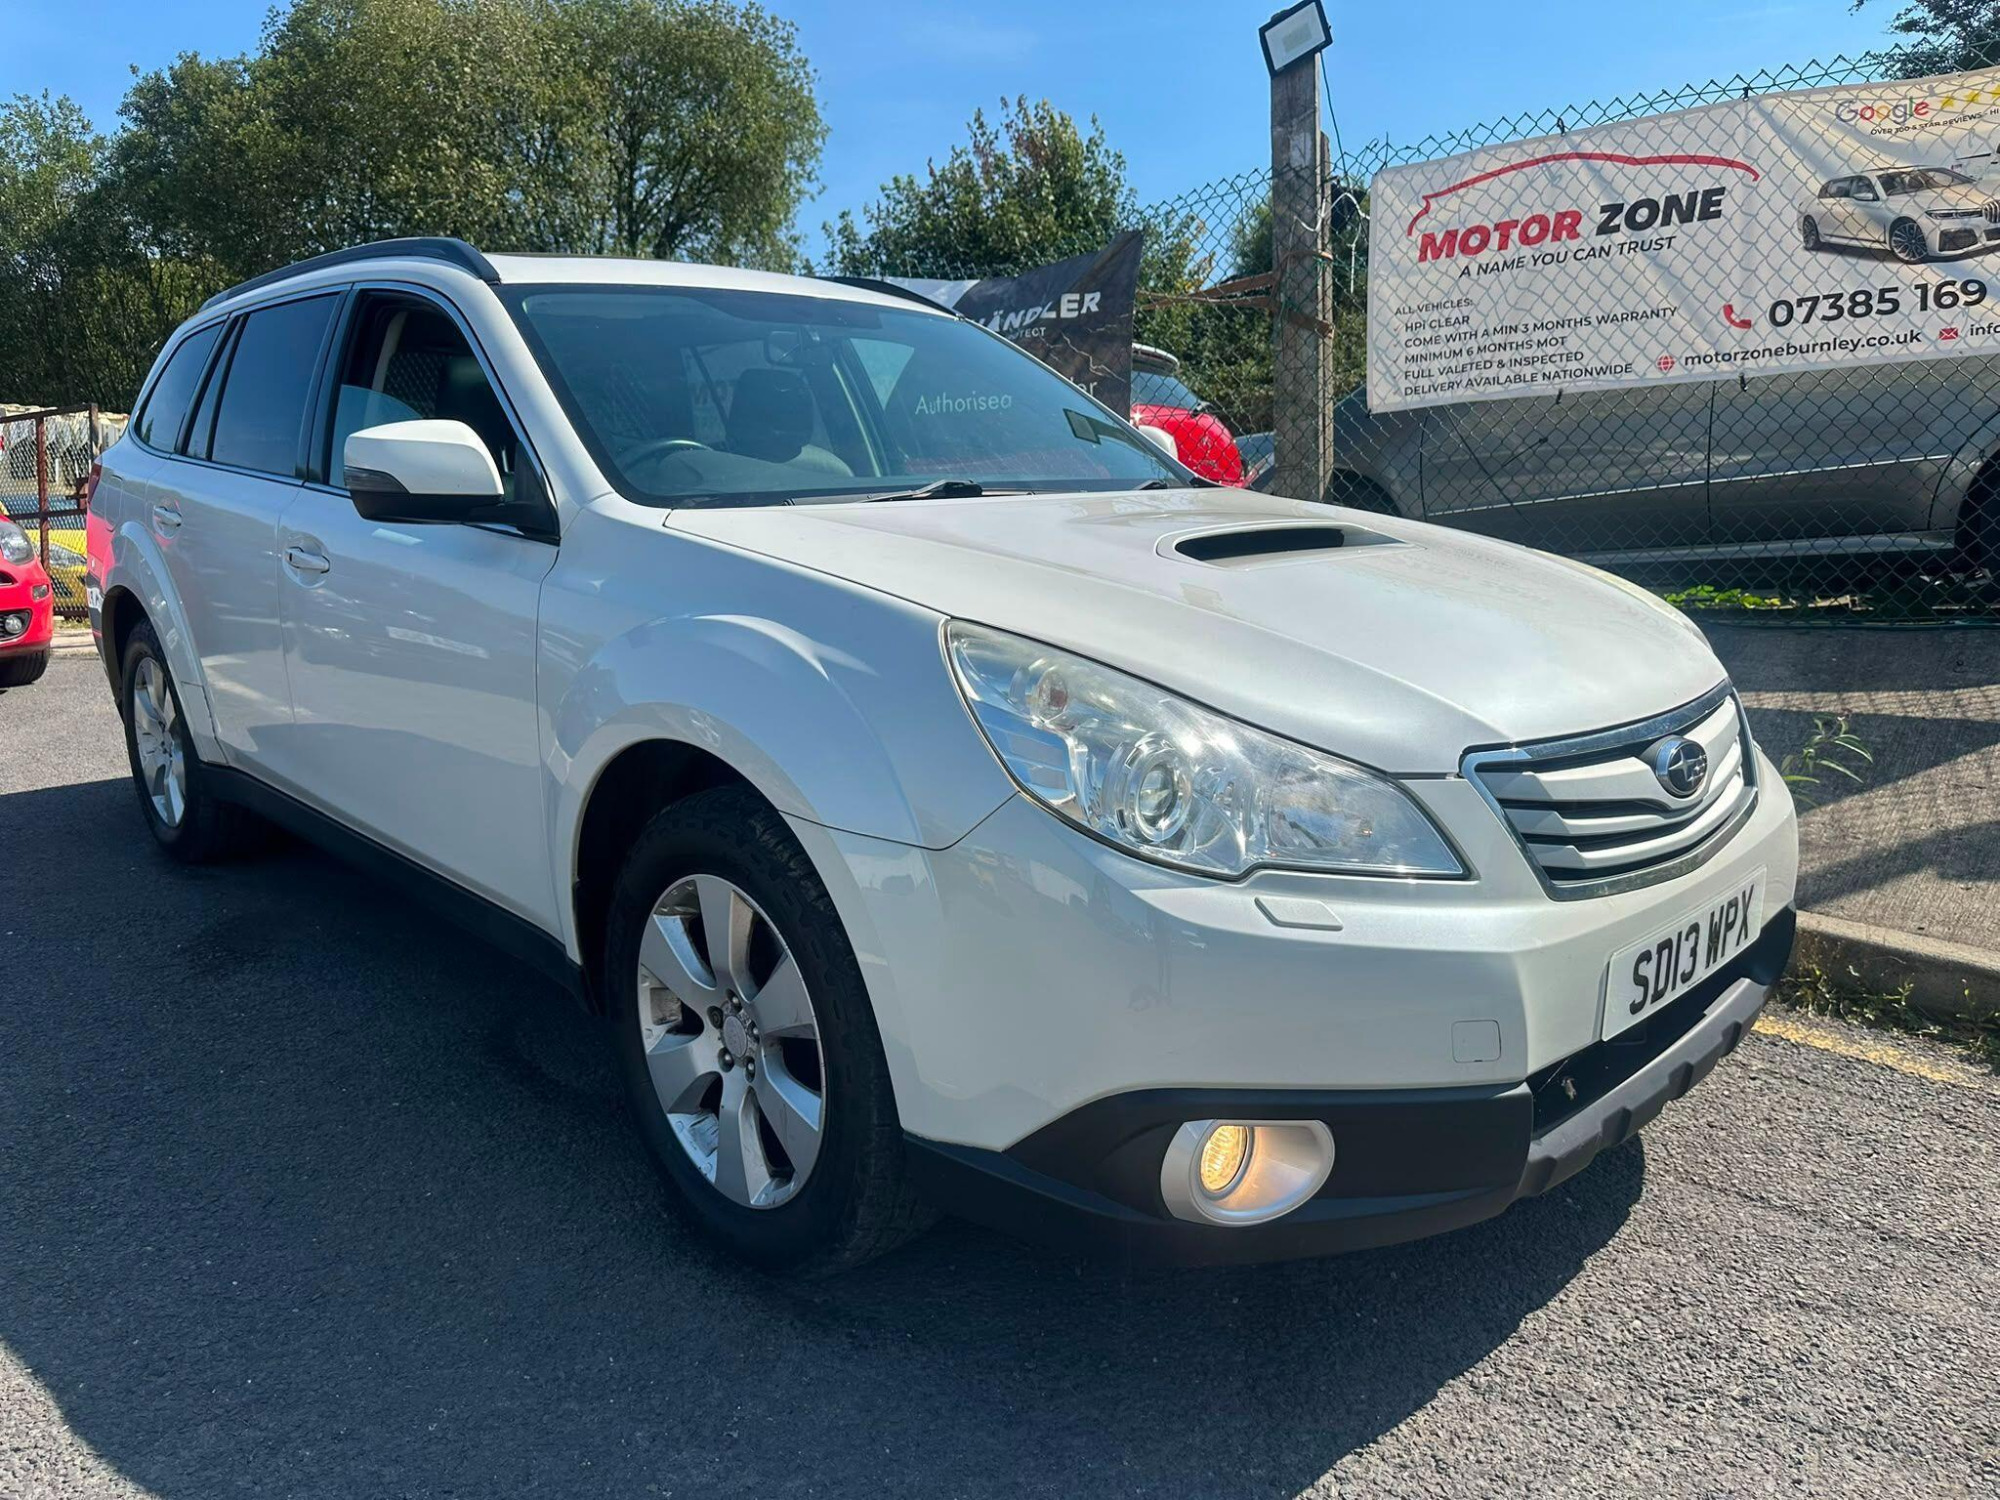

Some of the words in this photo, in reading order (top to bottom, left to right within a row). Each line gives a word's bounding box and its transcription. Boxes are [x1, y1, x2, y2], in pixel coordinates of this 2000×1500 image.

[1835, 96, 1930, 125] Google
[1418, 210, 1583, 263] MOTOR
[1595, 186, 1726, 237] ZONE
[1458, 265, 1472, 278] A
[1476, 256, 1526, 276] NAME
[1531, 249, 1568, 267] YOU
[1572, 245, 1612, 262] CAN
[1616, 235, 1677, 256] TRUST
[979, 291, 1101, 332] ÄNDLER
[1394, 306, 1414, 316] ALL
[1417, 297, 1474, 313] VEHICLES:
[1428, 315, 1470, 329] CLEAR
[1768, 286, 1900, 328] 07385
[1914, 278, 1988, 312] 169
[1405, 335, 1441, 348] COME
[1444, 330, 1478, 343] WITH
[1481, 328, 1490, 338] A
[1493, 324, 1518, 336] MIN
[1521, 323, 1529, 333] 3
[1533, 316, 1592, 332] MONTHS
[1596, 306, 1677, 325] WARRANTY
[1405, 348, 1463, 364] MINIMUM
[1466, 346, 1474, 357] 6
[1477, 340, 1533, 355] MONTHS
[1537, 336, 1567, 348] MOT
[1405, 369, 1434, 380] FULL
[1438, 360, 1493, 375] VALETED
[1496, 358, 1506, 369] &
[1509, 351, 1584, 367] INSPECTED
[1684, 329, 1922, 367] motorzoneburnley.co.uk
[1405, 380, 1462, 396] DELIVERY
[1465, 372, 1538, 388] AVAILABLE
[1542, 363, 1633, 381] NATIONWIDE
[1629, 921, 1700, 1016] SD13
[1704, 883, 1755, 970] WPX
